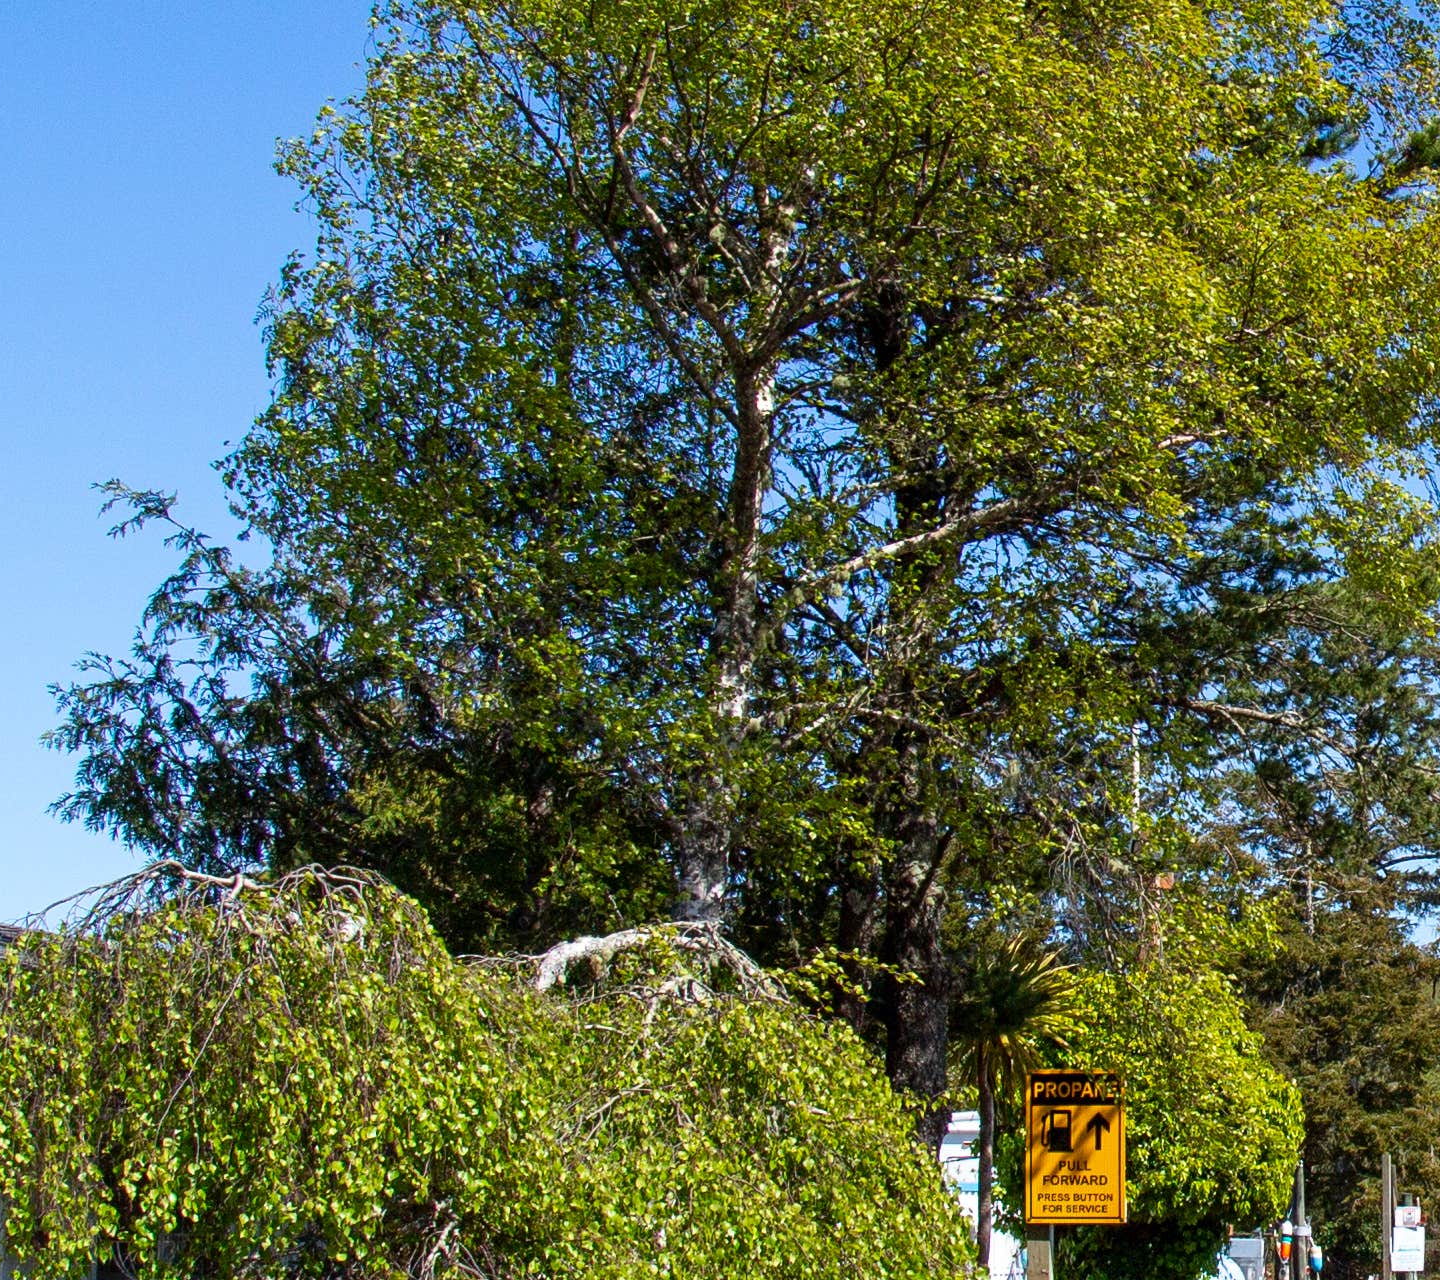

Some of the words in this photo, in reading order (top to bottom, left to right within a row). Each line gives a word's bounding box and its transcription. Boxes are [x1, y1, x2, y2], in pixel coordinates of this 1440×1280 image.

[1034, 1081, 1117, 1098] PROPANE
[1059, 1160, 1092, 1171] PULL
[1042, 1175, 1108, 1186] FORWARD
[1037, 1193, 1071, 1202] PRESS
[1073, 1193, 1113, 1202] BUTTON
[1042, 1204, 1063, 1213] FOR
[1065, 1204, 1109, 1213] SERVICE
